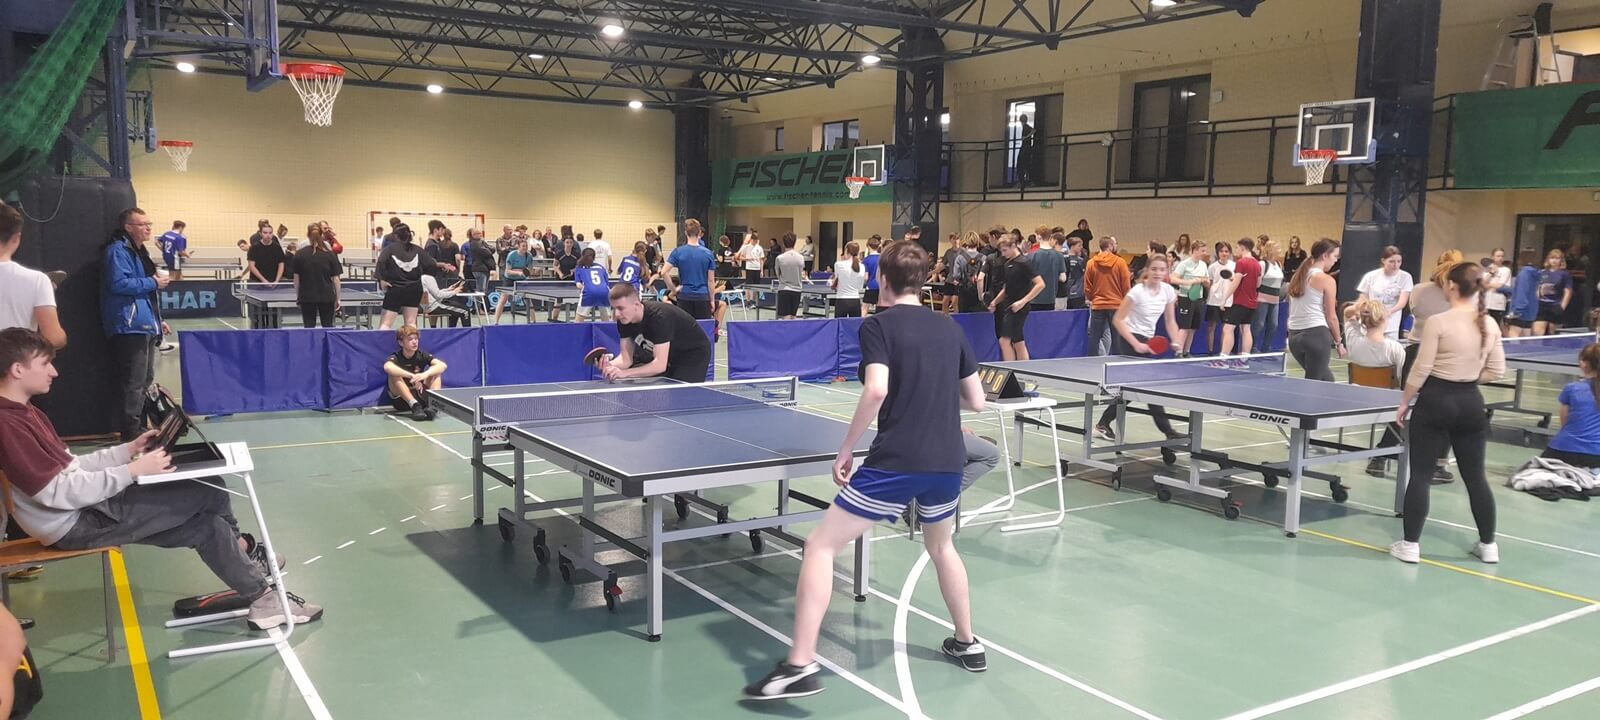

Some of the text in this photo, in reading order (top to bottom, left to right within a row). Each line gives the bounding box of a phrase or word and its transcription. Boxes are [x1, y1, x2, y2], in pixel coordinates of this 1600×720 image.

[165, 241, 172, 253] 12
[590, 270, 601, 285] 5
[623, 267, 634, 281] 8
[992, 374, 1004, 392] 0
[1249, 412, 1290, 424] DONIC
[588, 469, 616, 488] DONIC
